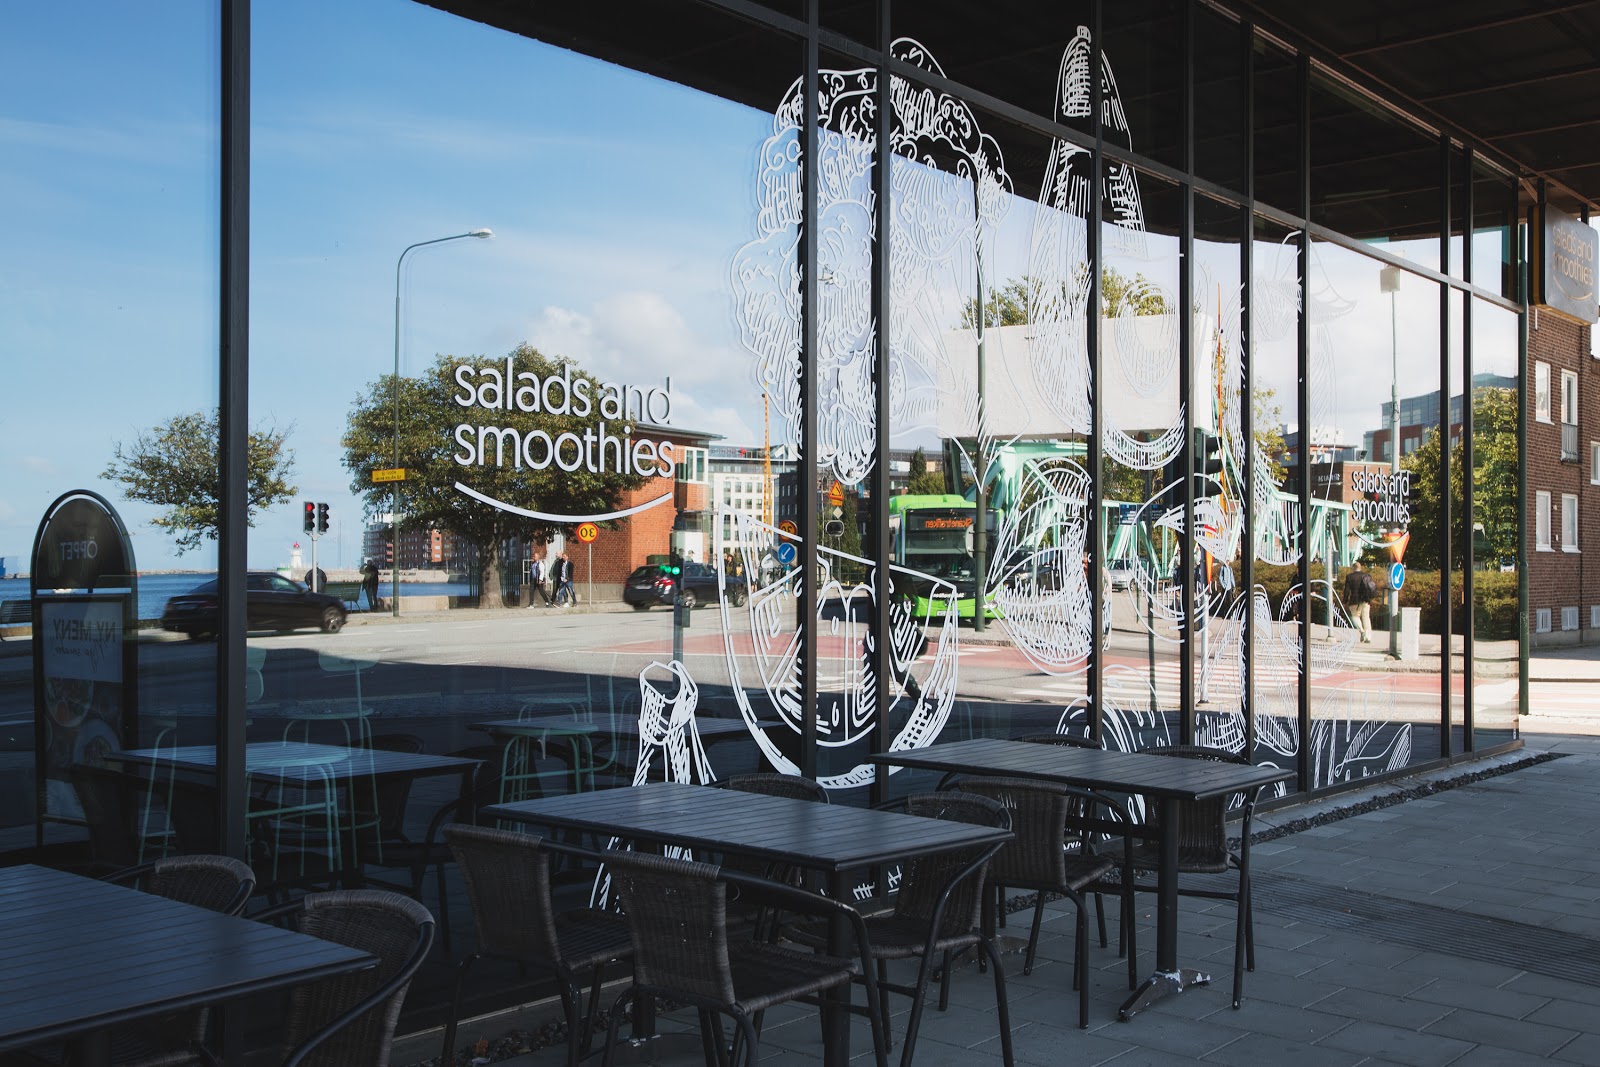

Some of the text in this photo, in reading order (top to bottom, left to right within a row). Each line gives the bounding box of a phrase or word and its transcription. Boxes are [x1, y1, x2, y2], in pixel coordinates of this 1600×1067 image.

[1577, 239, 1593, 262] and
[1552, 251, 1594, 286] smoothies
[454, 356, 673, 425] salads and
[453, 421, 676, 479] smoothies
[1352, 465, 1410, 497] salads and
[1352, 496, 1411, 524] smoothies
